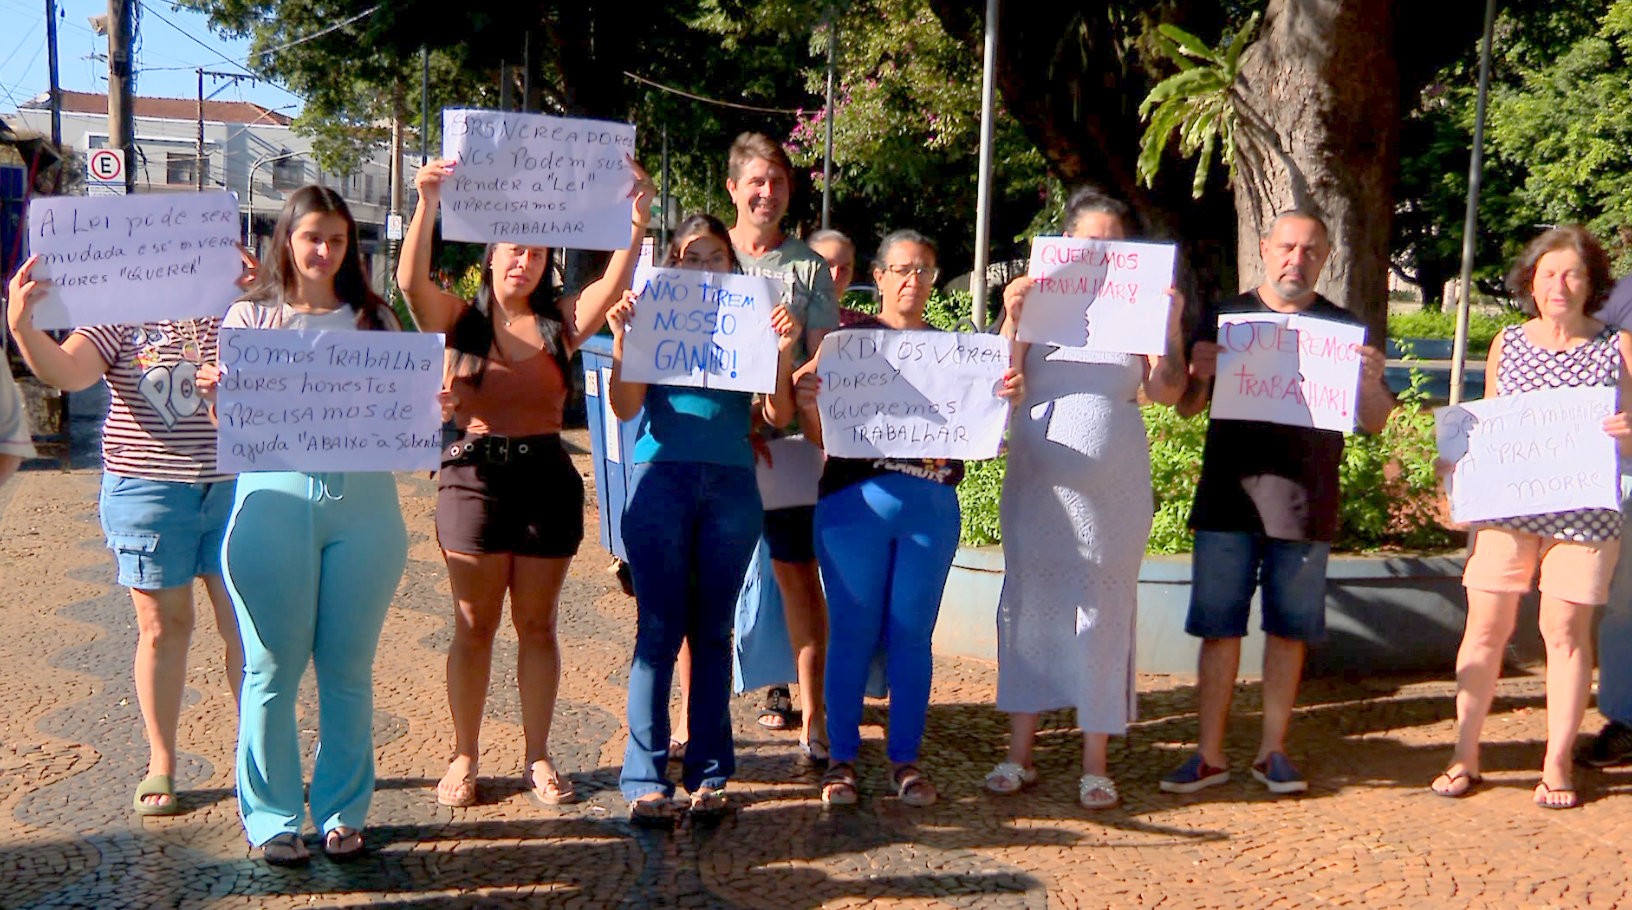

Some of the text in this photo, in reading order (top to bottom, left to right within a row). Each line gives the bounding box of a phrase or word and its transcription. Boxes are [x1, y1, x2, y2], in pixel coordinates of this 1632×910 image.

[101, 157, 112, 174] E
[532, 181, 545, 193] a
[40, 208, 56, 237] A
[125, 206, 188, 238] pode
[1040, 244, 1139, 271] QUEREMOS
[641, 273, 689, 304] NÃO
[653, 309, 737, 335] NOSSO
[836, 335, 877, 361] KD
[1226, 317, 1358, 365] QUEREMOS
[654, 340, 738, 379] GANHO!
[383, 401, 415, 422] de
[232, 433, 290, 463] ajuda
